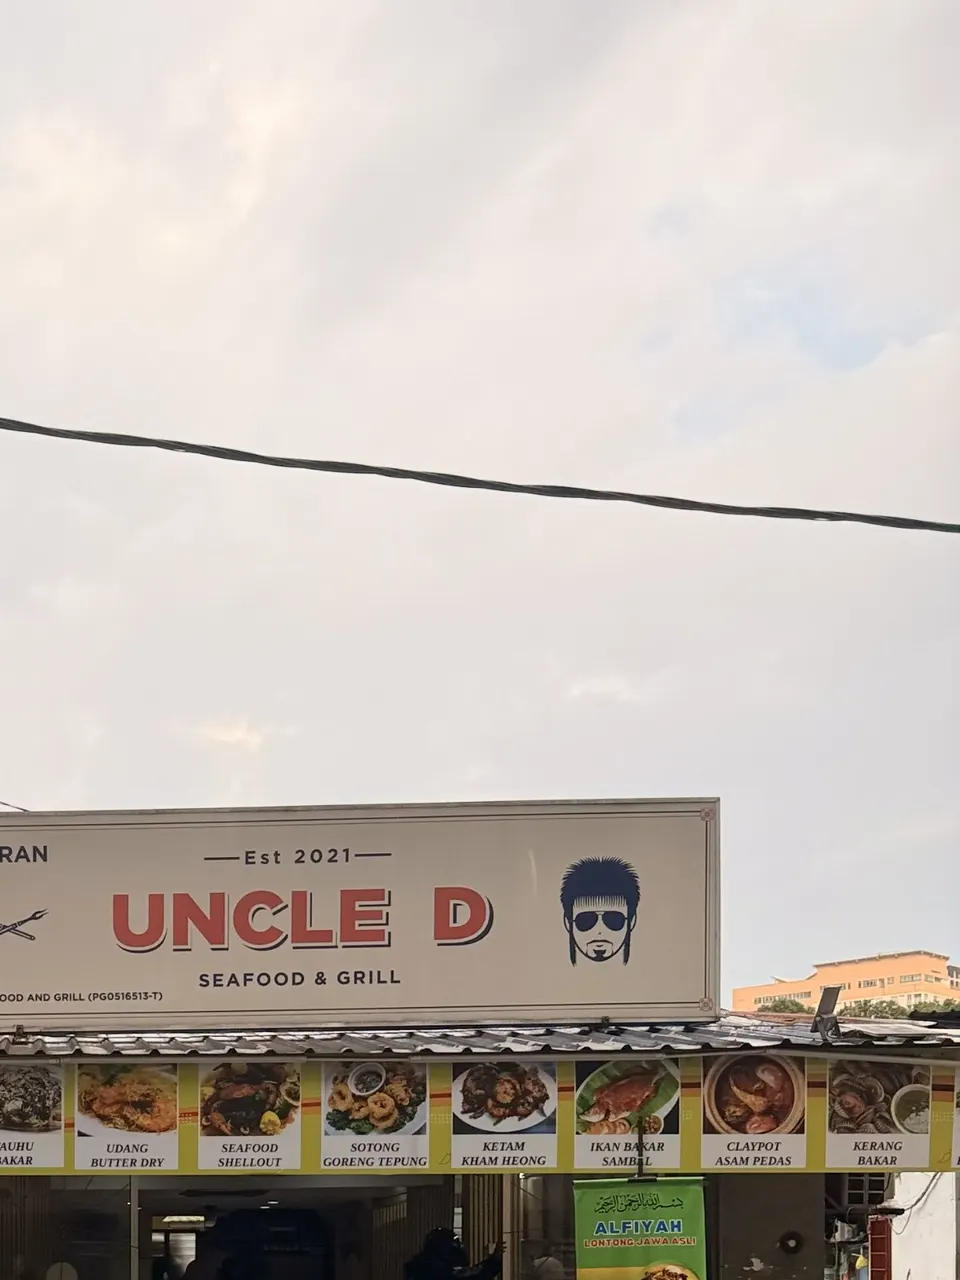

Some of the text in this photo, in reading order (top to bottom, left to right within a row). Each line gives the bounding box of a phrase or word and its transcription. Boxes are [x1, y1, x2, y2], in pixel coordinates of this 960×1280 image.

[244, 847, 350, 866] Est 2021
[112, 887, 494, 953] UNCLE D
[198, 969, 401, 988] SEAFOOD & GRILL
[26, 993, 51, 1002] AND
[53, 992, 86, 1002] GRILL
[106, 1143, 149, 1154] UDANG
[221, 1143, 279, 1154] SEAFOOD
[350, 1142, 400, 1153] SOTONG
[482, 1141, 526, 1152] KETAM
[590, 1142, 621, 1152] IKAN
[726, 1141, 782, 1152] CLAYPOT
[852, 1141, 903, 1152] KERANG
[90, 1157, 165, 1168] BUTTER DRY
[217, 1157, 283, 1168] SHELLOUT
[322, 1156, 428, 1167] GORENG TEPUNG
[461, 1155, 547, 1166] KHAM HEONG
[602, 1156, 652, 1167] SAMBL
[714, 1156, 792, 1166] ASAM PEDAS
[857, 1155, 898, 1166] BAKAR
[594, 1219, 683, 1235] ALFIYAH
[584, 1236, 696, 1248] LONTONG JAWA ASLI
